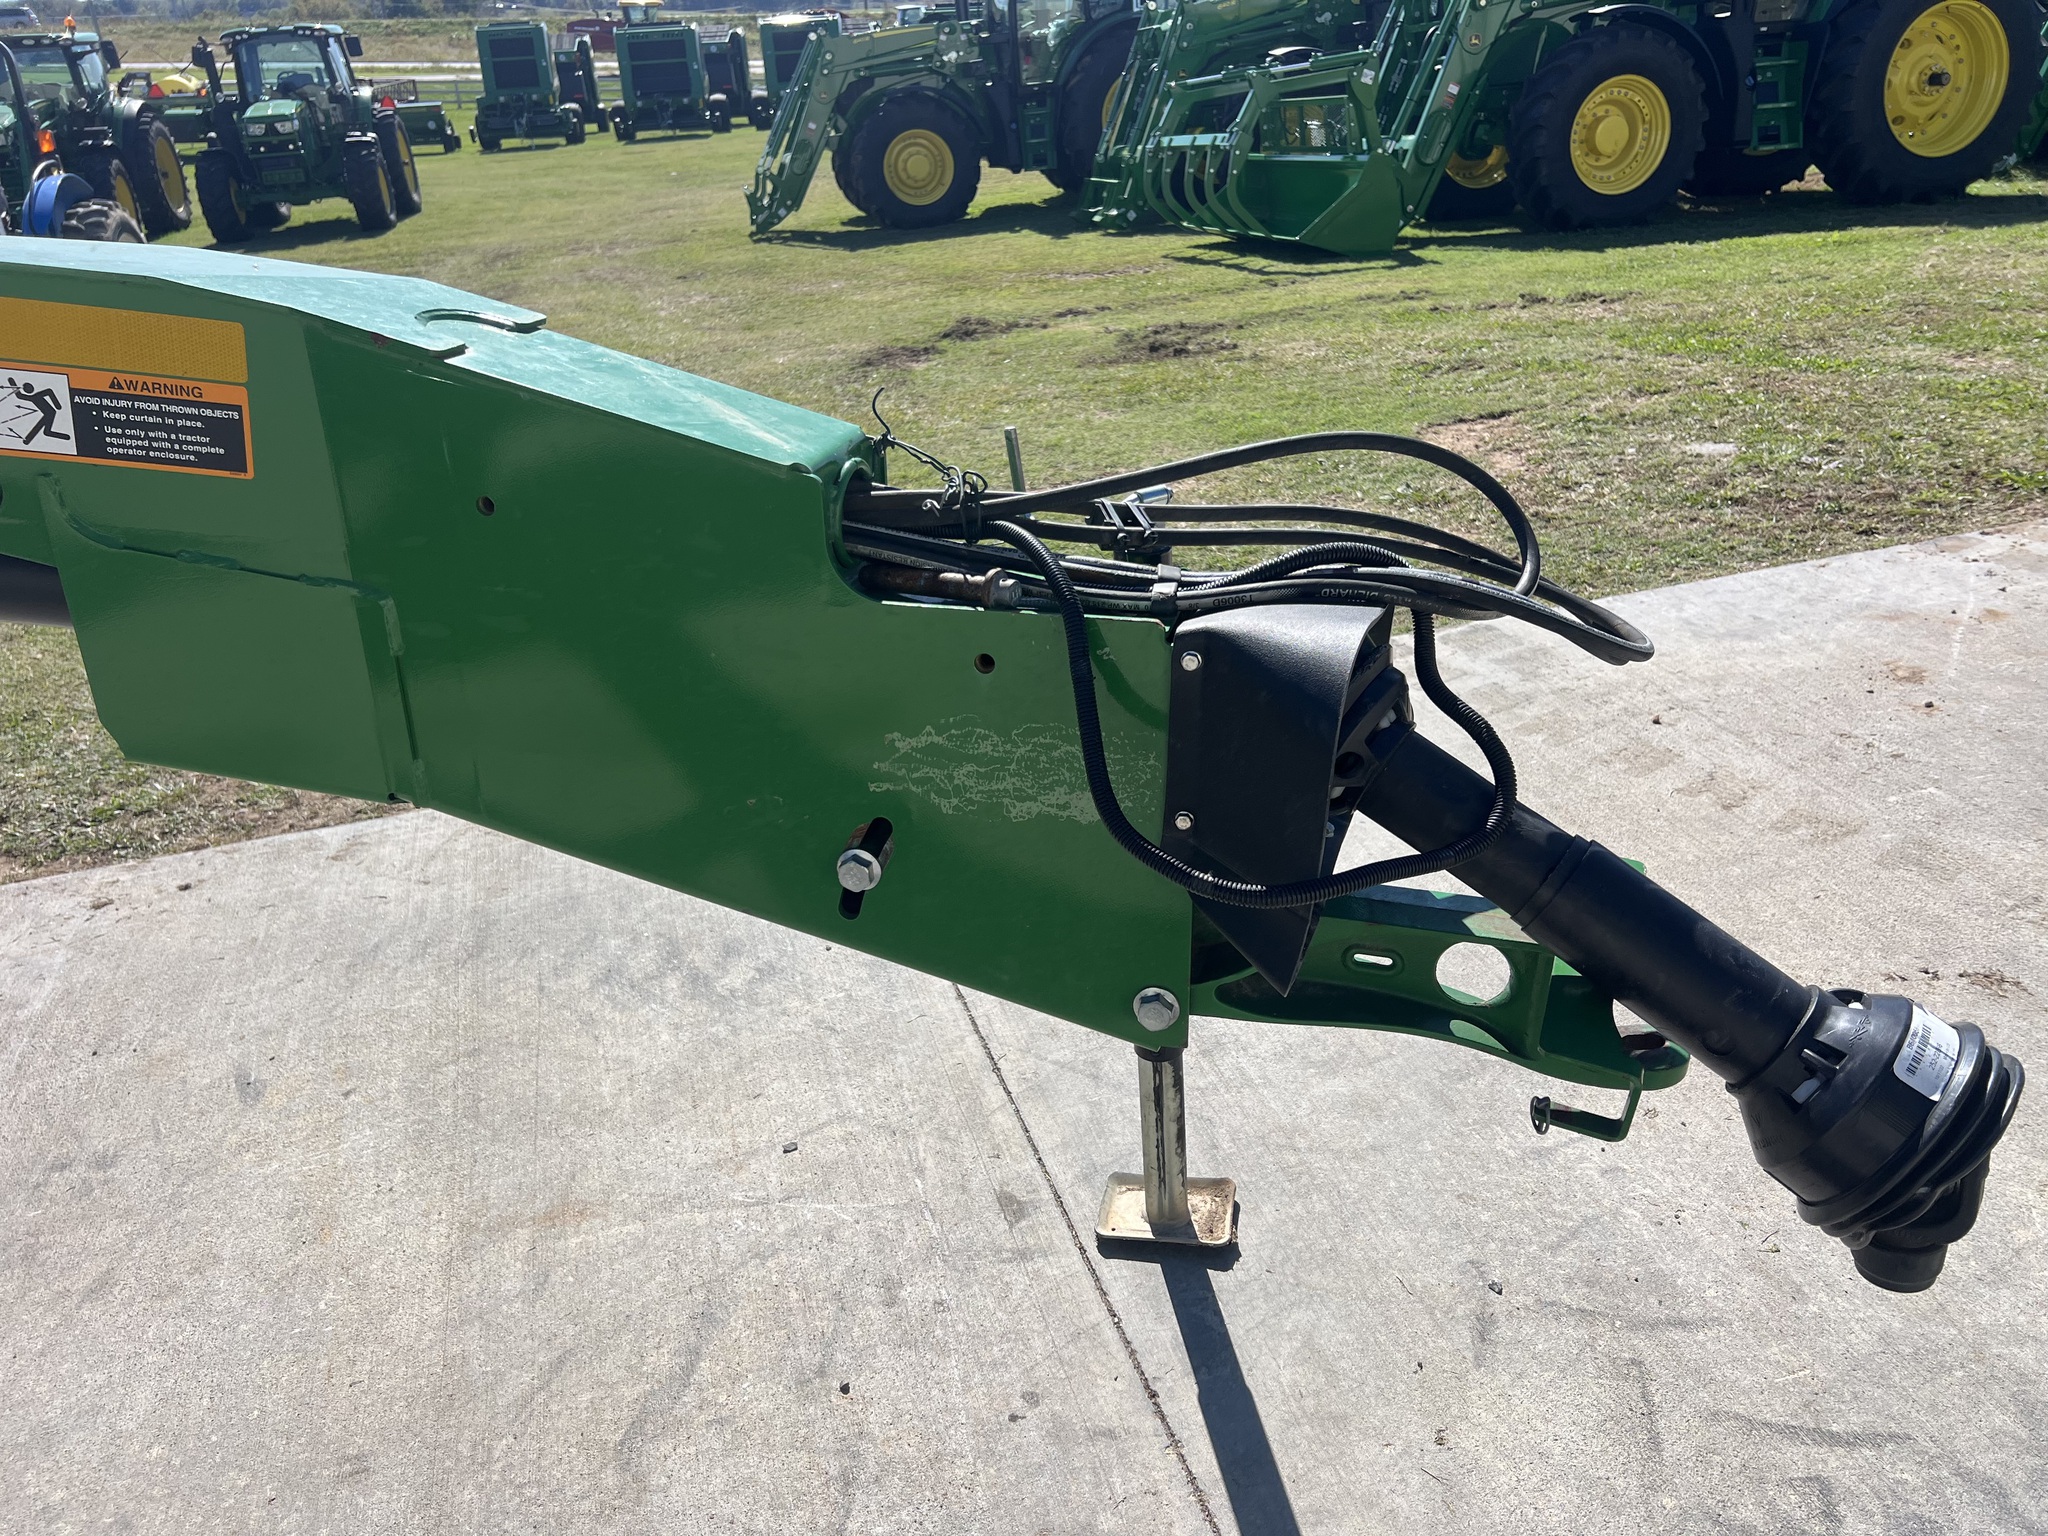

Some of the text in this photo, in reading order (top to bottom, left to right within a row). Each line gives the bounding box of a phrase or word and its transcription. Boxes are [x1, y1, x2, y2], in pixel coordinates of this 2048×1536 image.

[123, 379, 203, 399] WARNING
[74, 395, 239, 420] AVOID INJURY FROM THROWN OBJECTS
[102, 410, 205, 428] Keep curtain in place.
[104, 425, 123, 435] Use
[125, 428, 145, 438] only
[147, 430, 168, 440] with
[178, 433, 211, 443] tractor
[105, 436, 149, 448] equipped
[151, 440, 172, 450] with
[182, 443, 225, 455] complete
[106, 446, 199, 462] operator enclosure.
[1121, 602, 1140, 611] MAX
